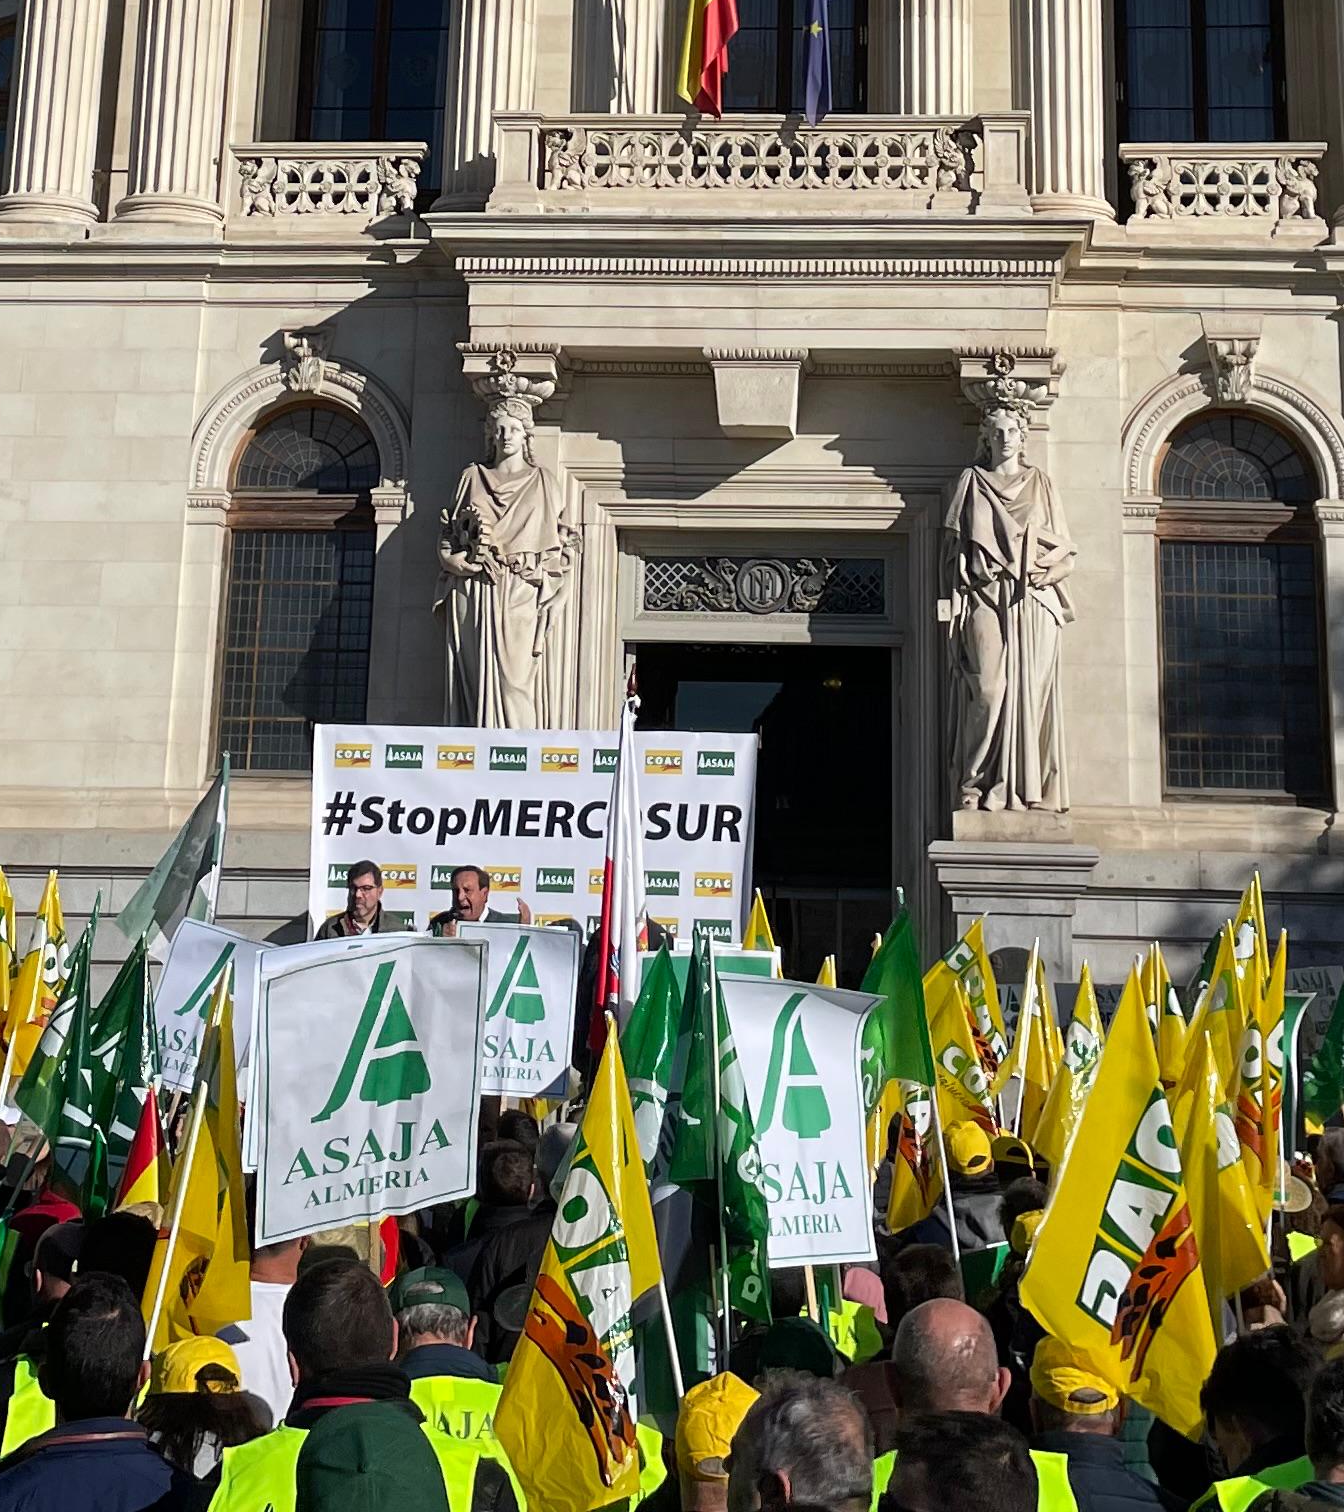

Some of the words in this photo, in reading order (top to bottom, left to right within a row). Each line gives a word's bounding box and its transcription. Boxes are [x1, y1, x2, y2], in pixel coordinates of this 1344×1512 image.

[322, 791, 742, 845] #StopMERCSUR
[482, 1034, 557, 1065] SAJA
[481, 1064, 543, 1082] LMERIA
[283, 1117, 453, 1186] ASAJA
[303, 1166, 431, 1210] ALMERIA
[763, 1159, 854, 1206] SAJA
[768, 1214, 843, 1239] LMERIA
